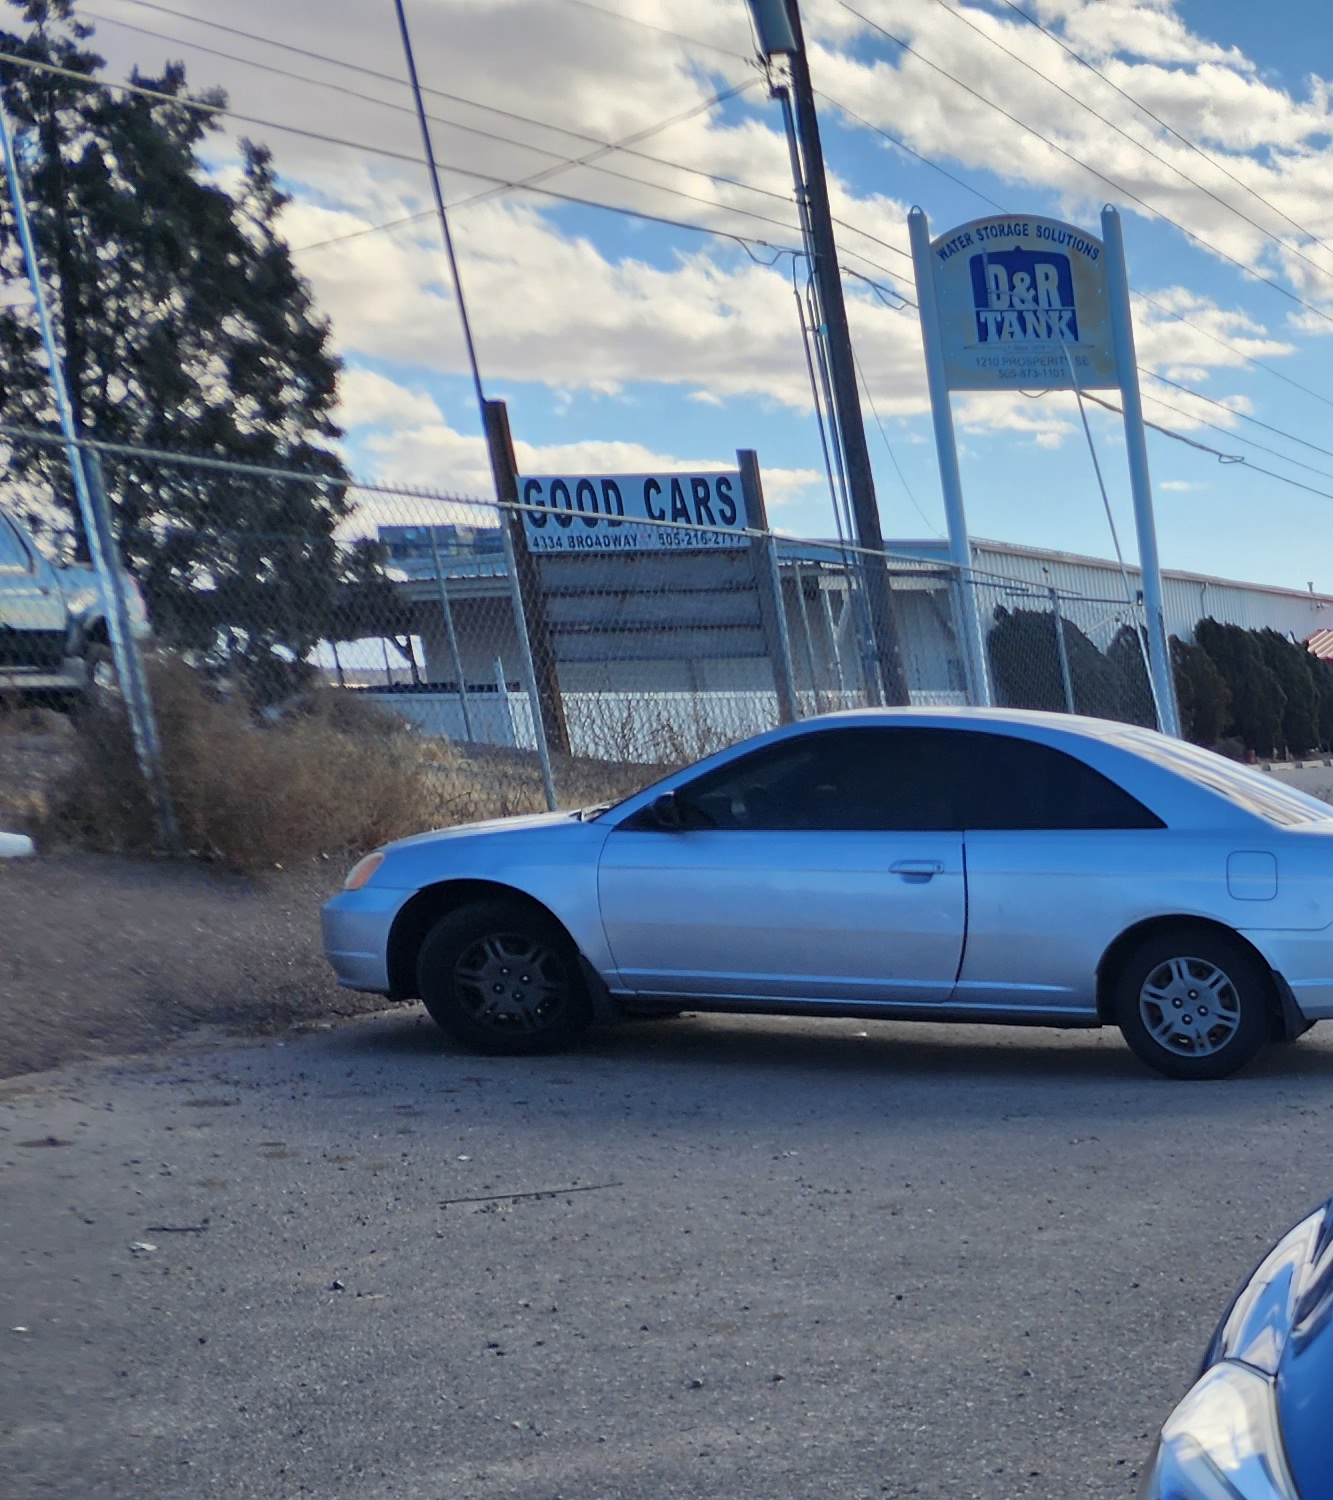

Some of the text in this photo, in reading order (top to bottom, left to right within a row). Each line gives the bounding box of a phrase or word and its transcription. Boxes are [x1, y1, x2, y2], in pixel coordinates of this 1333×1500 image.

[936, 223, 1100, 261] WATER STORAGE SOLUTIONS
[988, 263, 1059, 310] D&R
[979, 310, 1078, 342] TANK
[976, 356, 999, 367] 1210
[523, 476, 737, 529] GOOD CARS
[567, 534, 638, 549] BROADWAY
